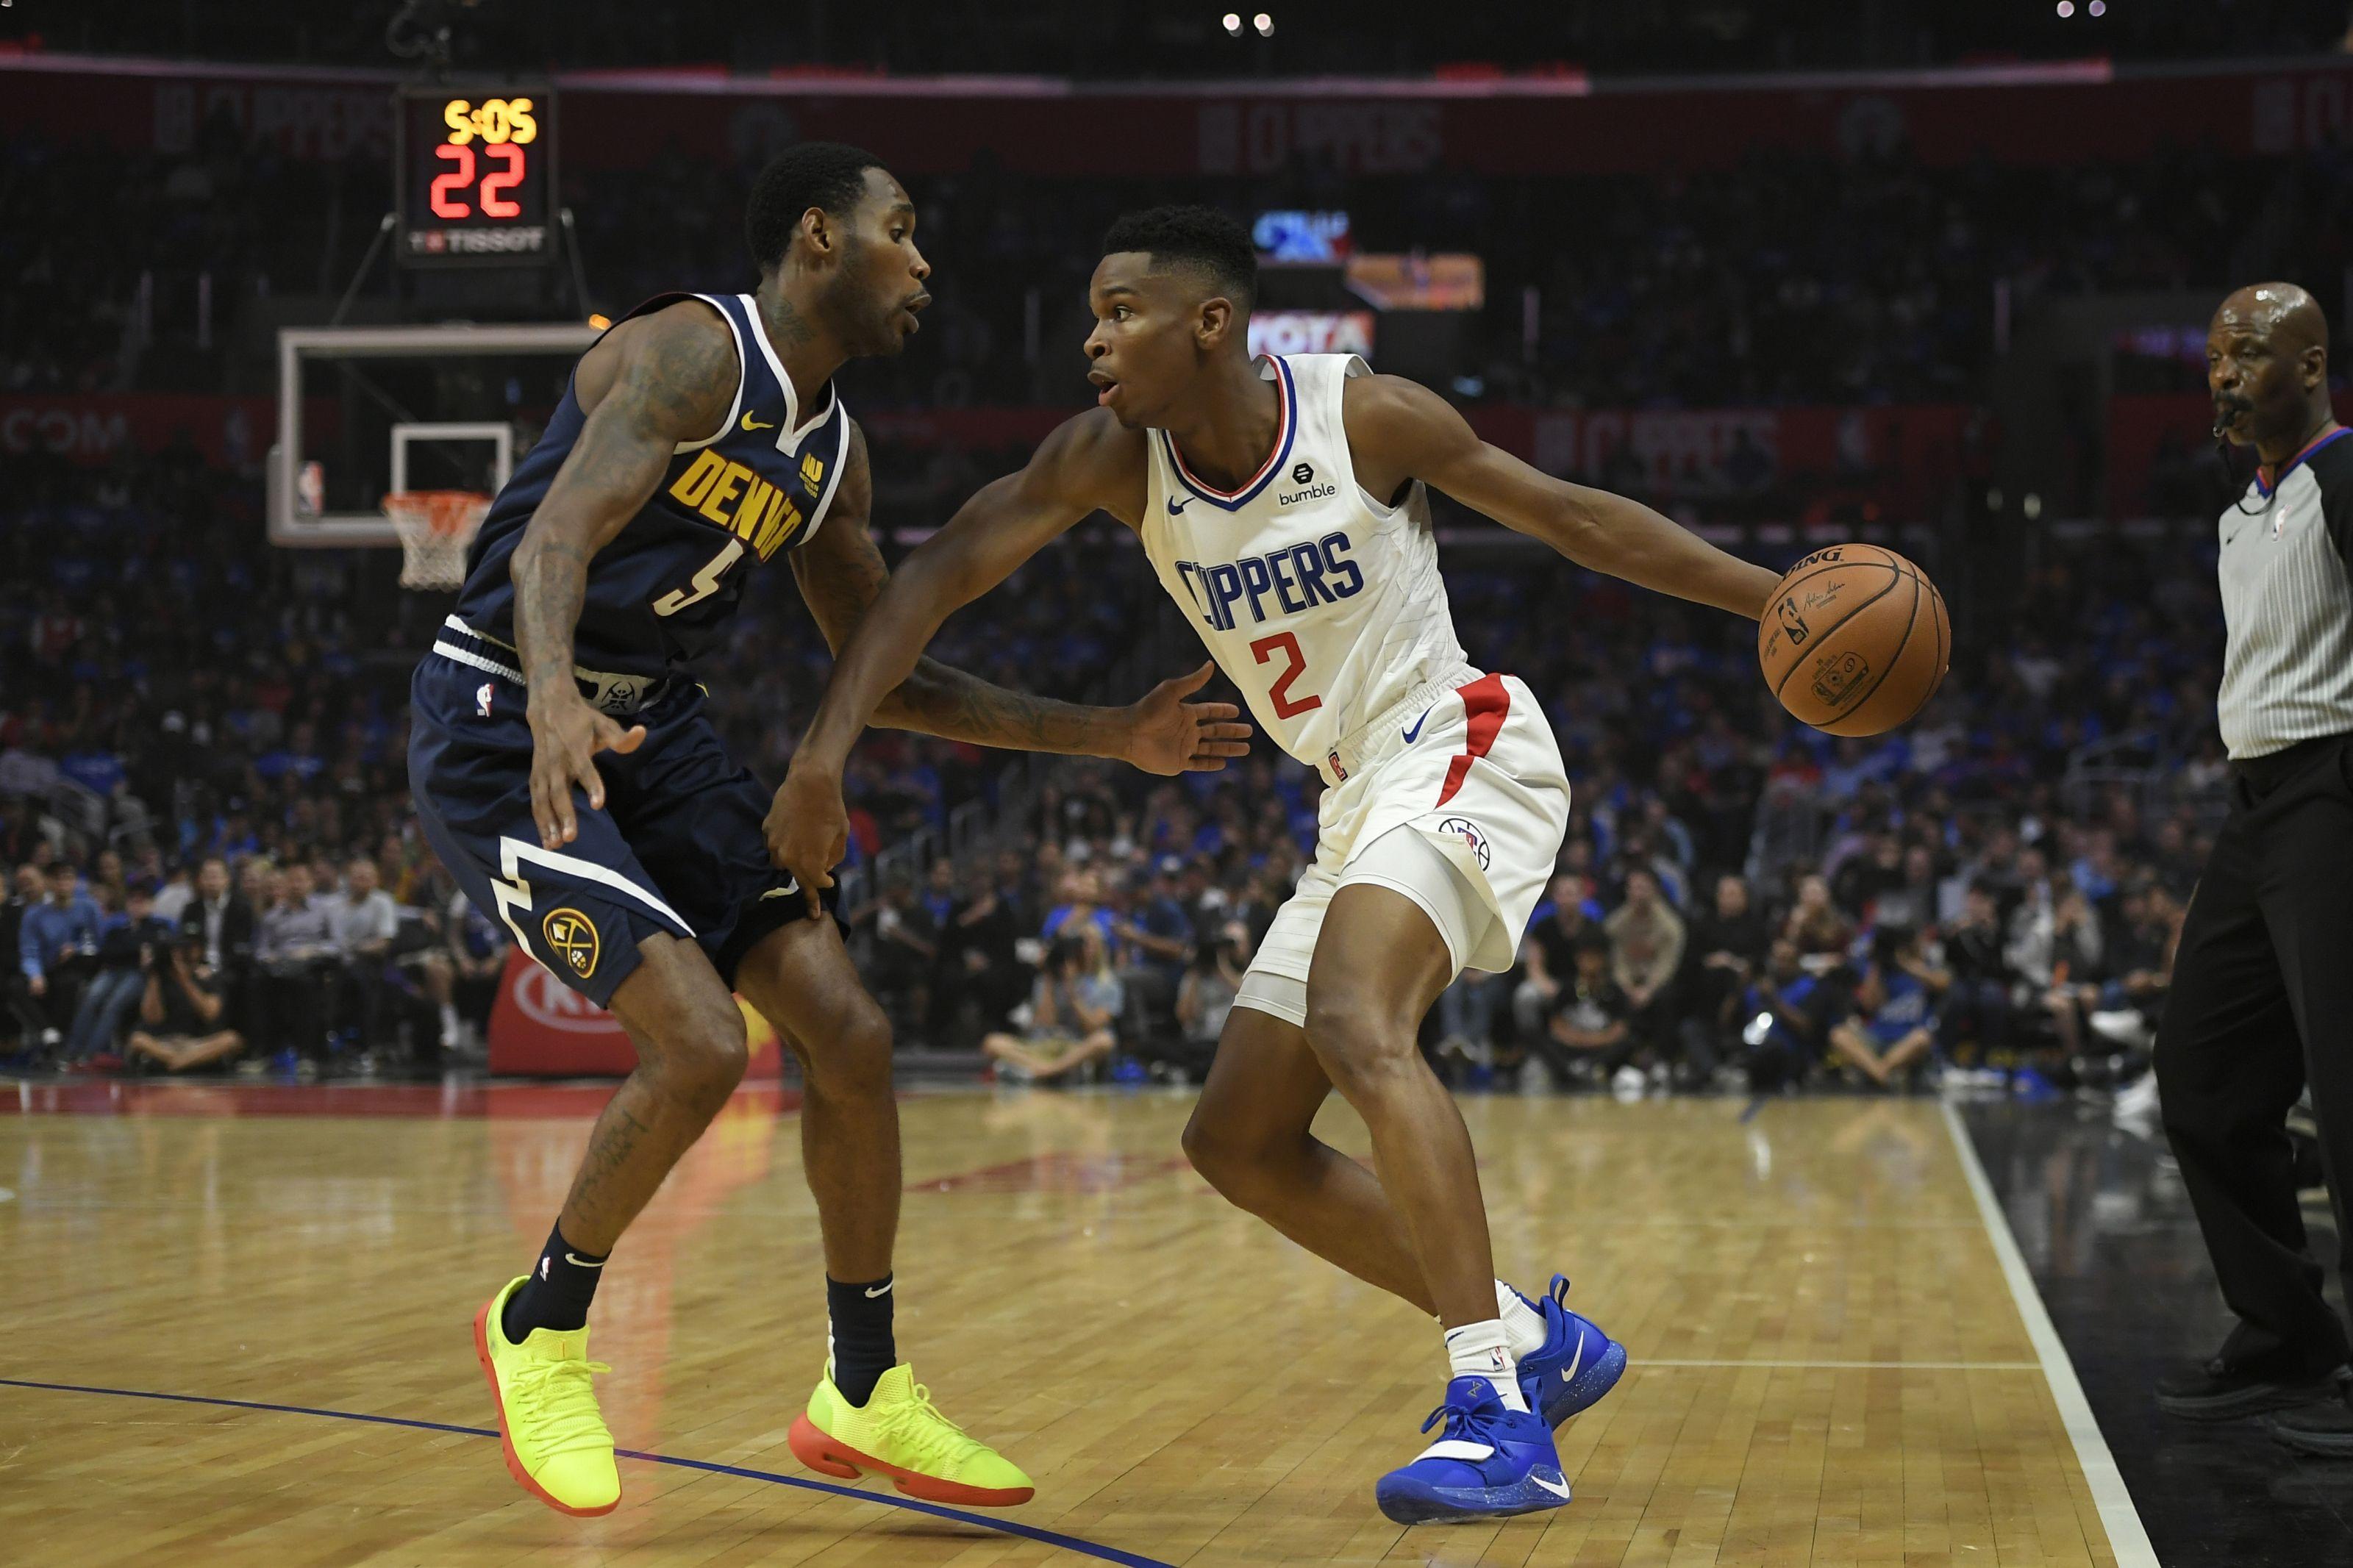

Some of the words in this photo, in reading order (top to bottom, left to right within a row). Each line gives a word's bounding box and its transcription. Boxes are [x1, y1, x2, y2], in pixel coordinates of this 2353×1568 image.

[444, 98, 537, 145] 5:05
[431, 143, 525, 218] 22
[447, 226, 545, 252] TISSOT
[1279, 483, 1336, 506] bumble
[651, 537, 745, 617] 5
[1249, 631, 1324, 720] 2
